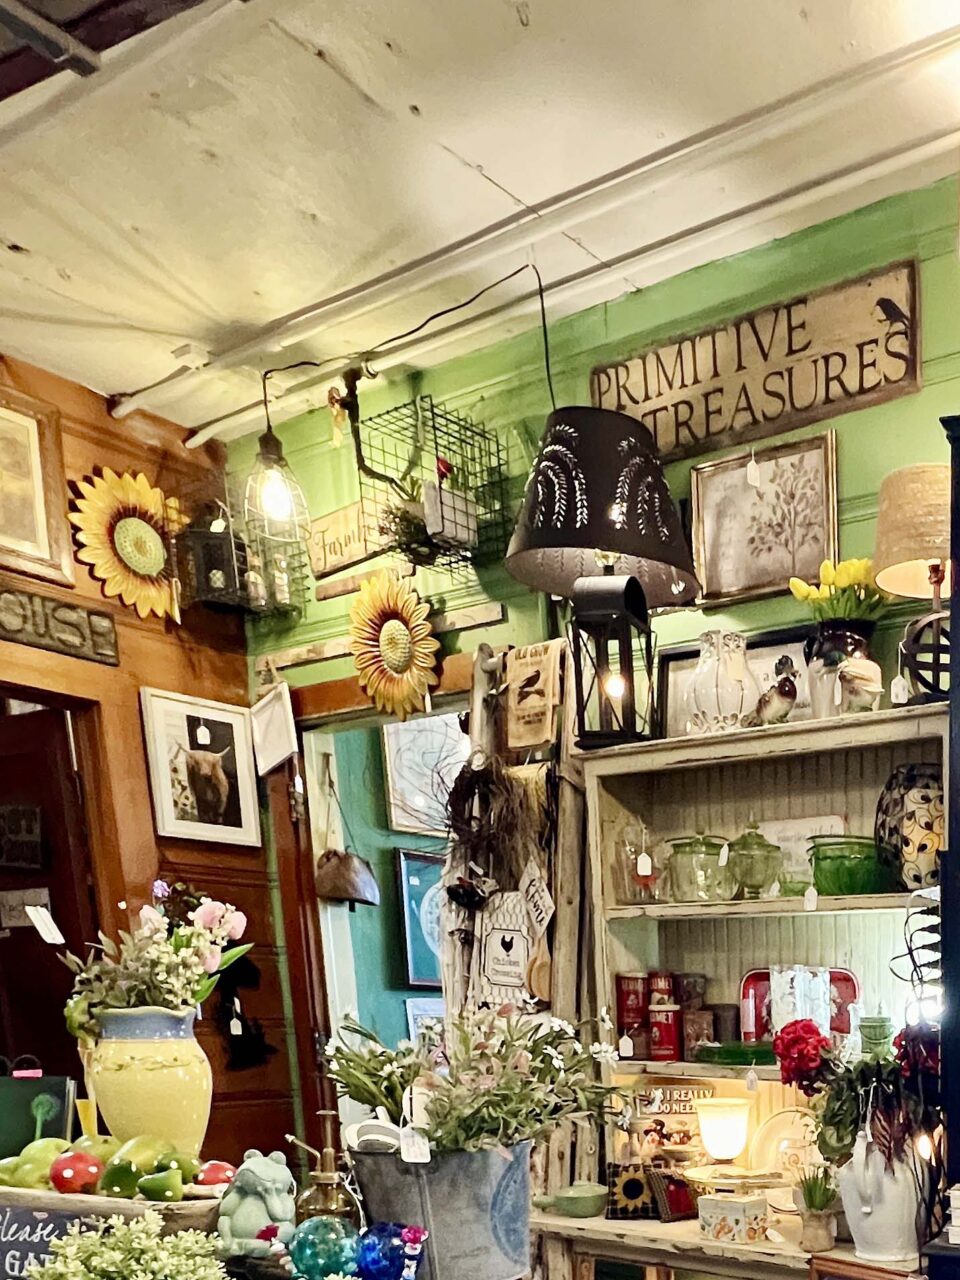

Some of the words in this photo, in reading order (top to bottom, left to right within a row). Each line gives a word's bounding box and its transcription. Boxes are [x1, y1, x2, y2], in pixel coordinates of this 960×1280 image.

[593, 297, 812, 411] PRIMITIVE
[641, 329, 911, 451] TREASURES
[673, 1103, 697, 1114] NEE
[0, 1207, 60, 1242] lease
